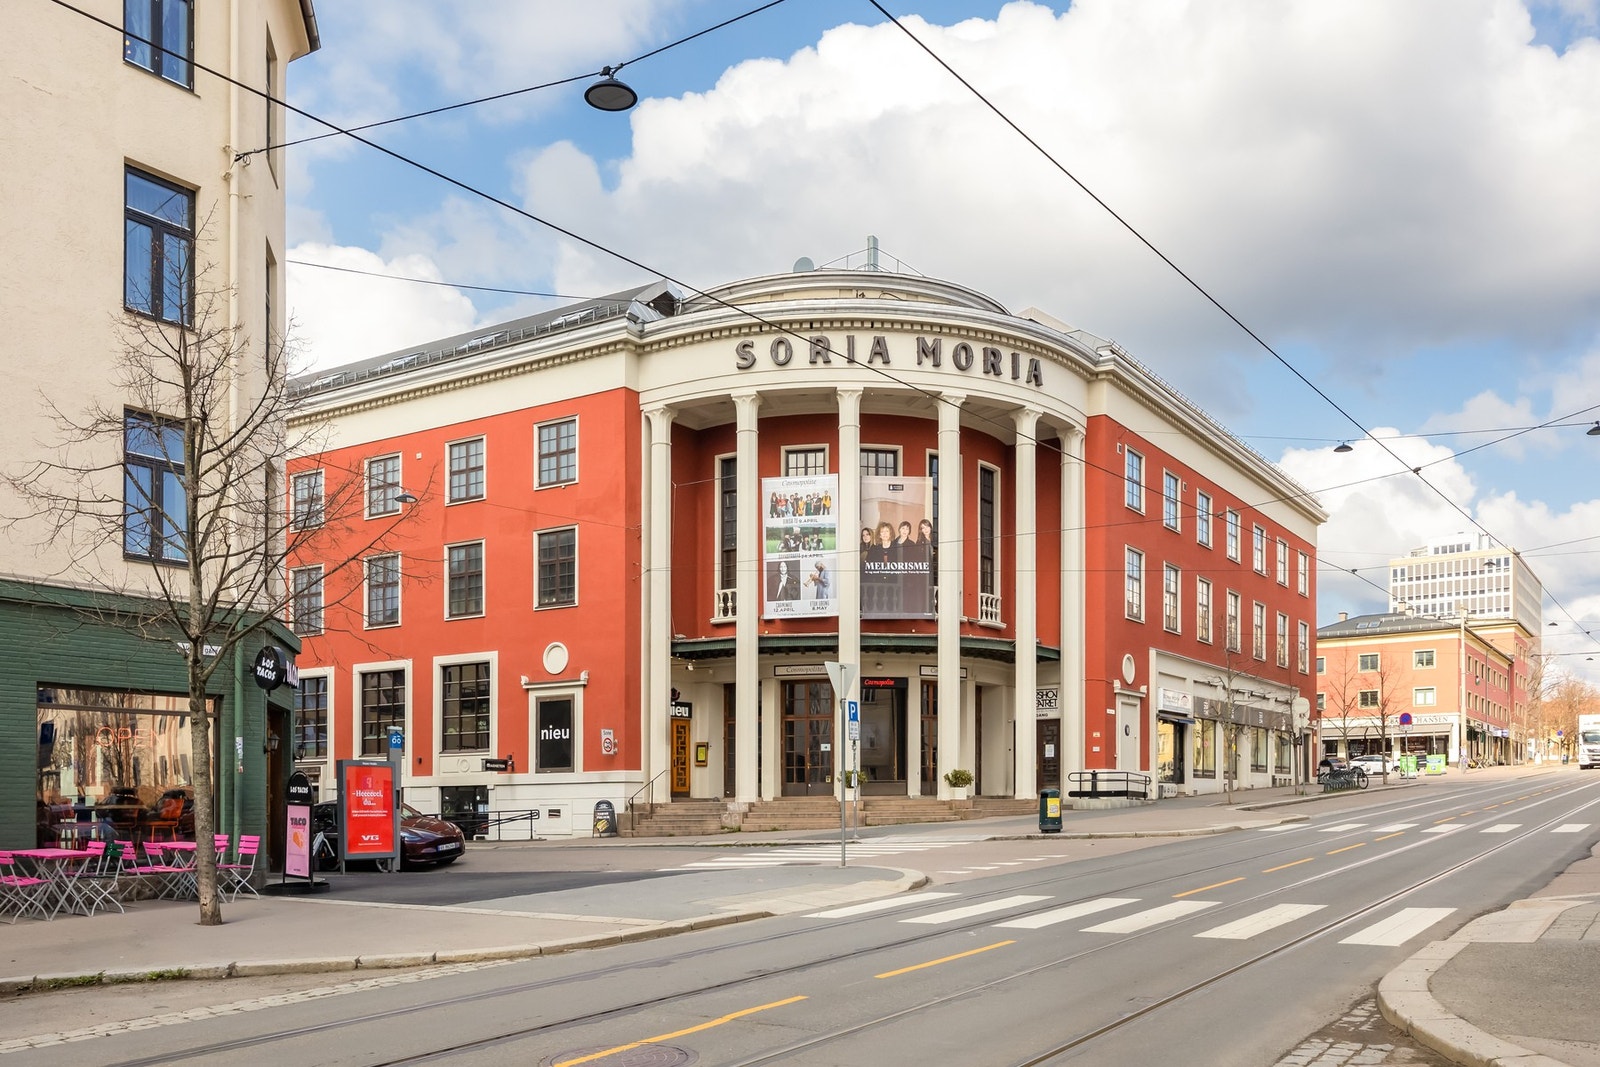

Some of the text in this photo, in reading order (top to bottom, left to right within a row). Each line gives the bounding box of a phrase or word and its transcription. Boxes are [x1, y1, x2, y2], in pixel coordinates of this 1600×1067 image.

[736, 335, 1044, 387] SORIA MORIA
[865, 562, 930, 570] MELIORISME
[261, 657, 275, 670] LOS
[256, 665, 276, 681] TACOS
[864, 679, 895, 687] Cosmopolite
[850, 703, 856, 719] P
[1416, 716, 1448, 724] HANSEN
[96, 726, 167, 748] OPEN
[540, 725, 570, 740] nieu
[290, 817, 307, 826] TACO
